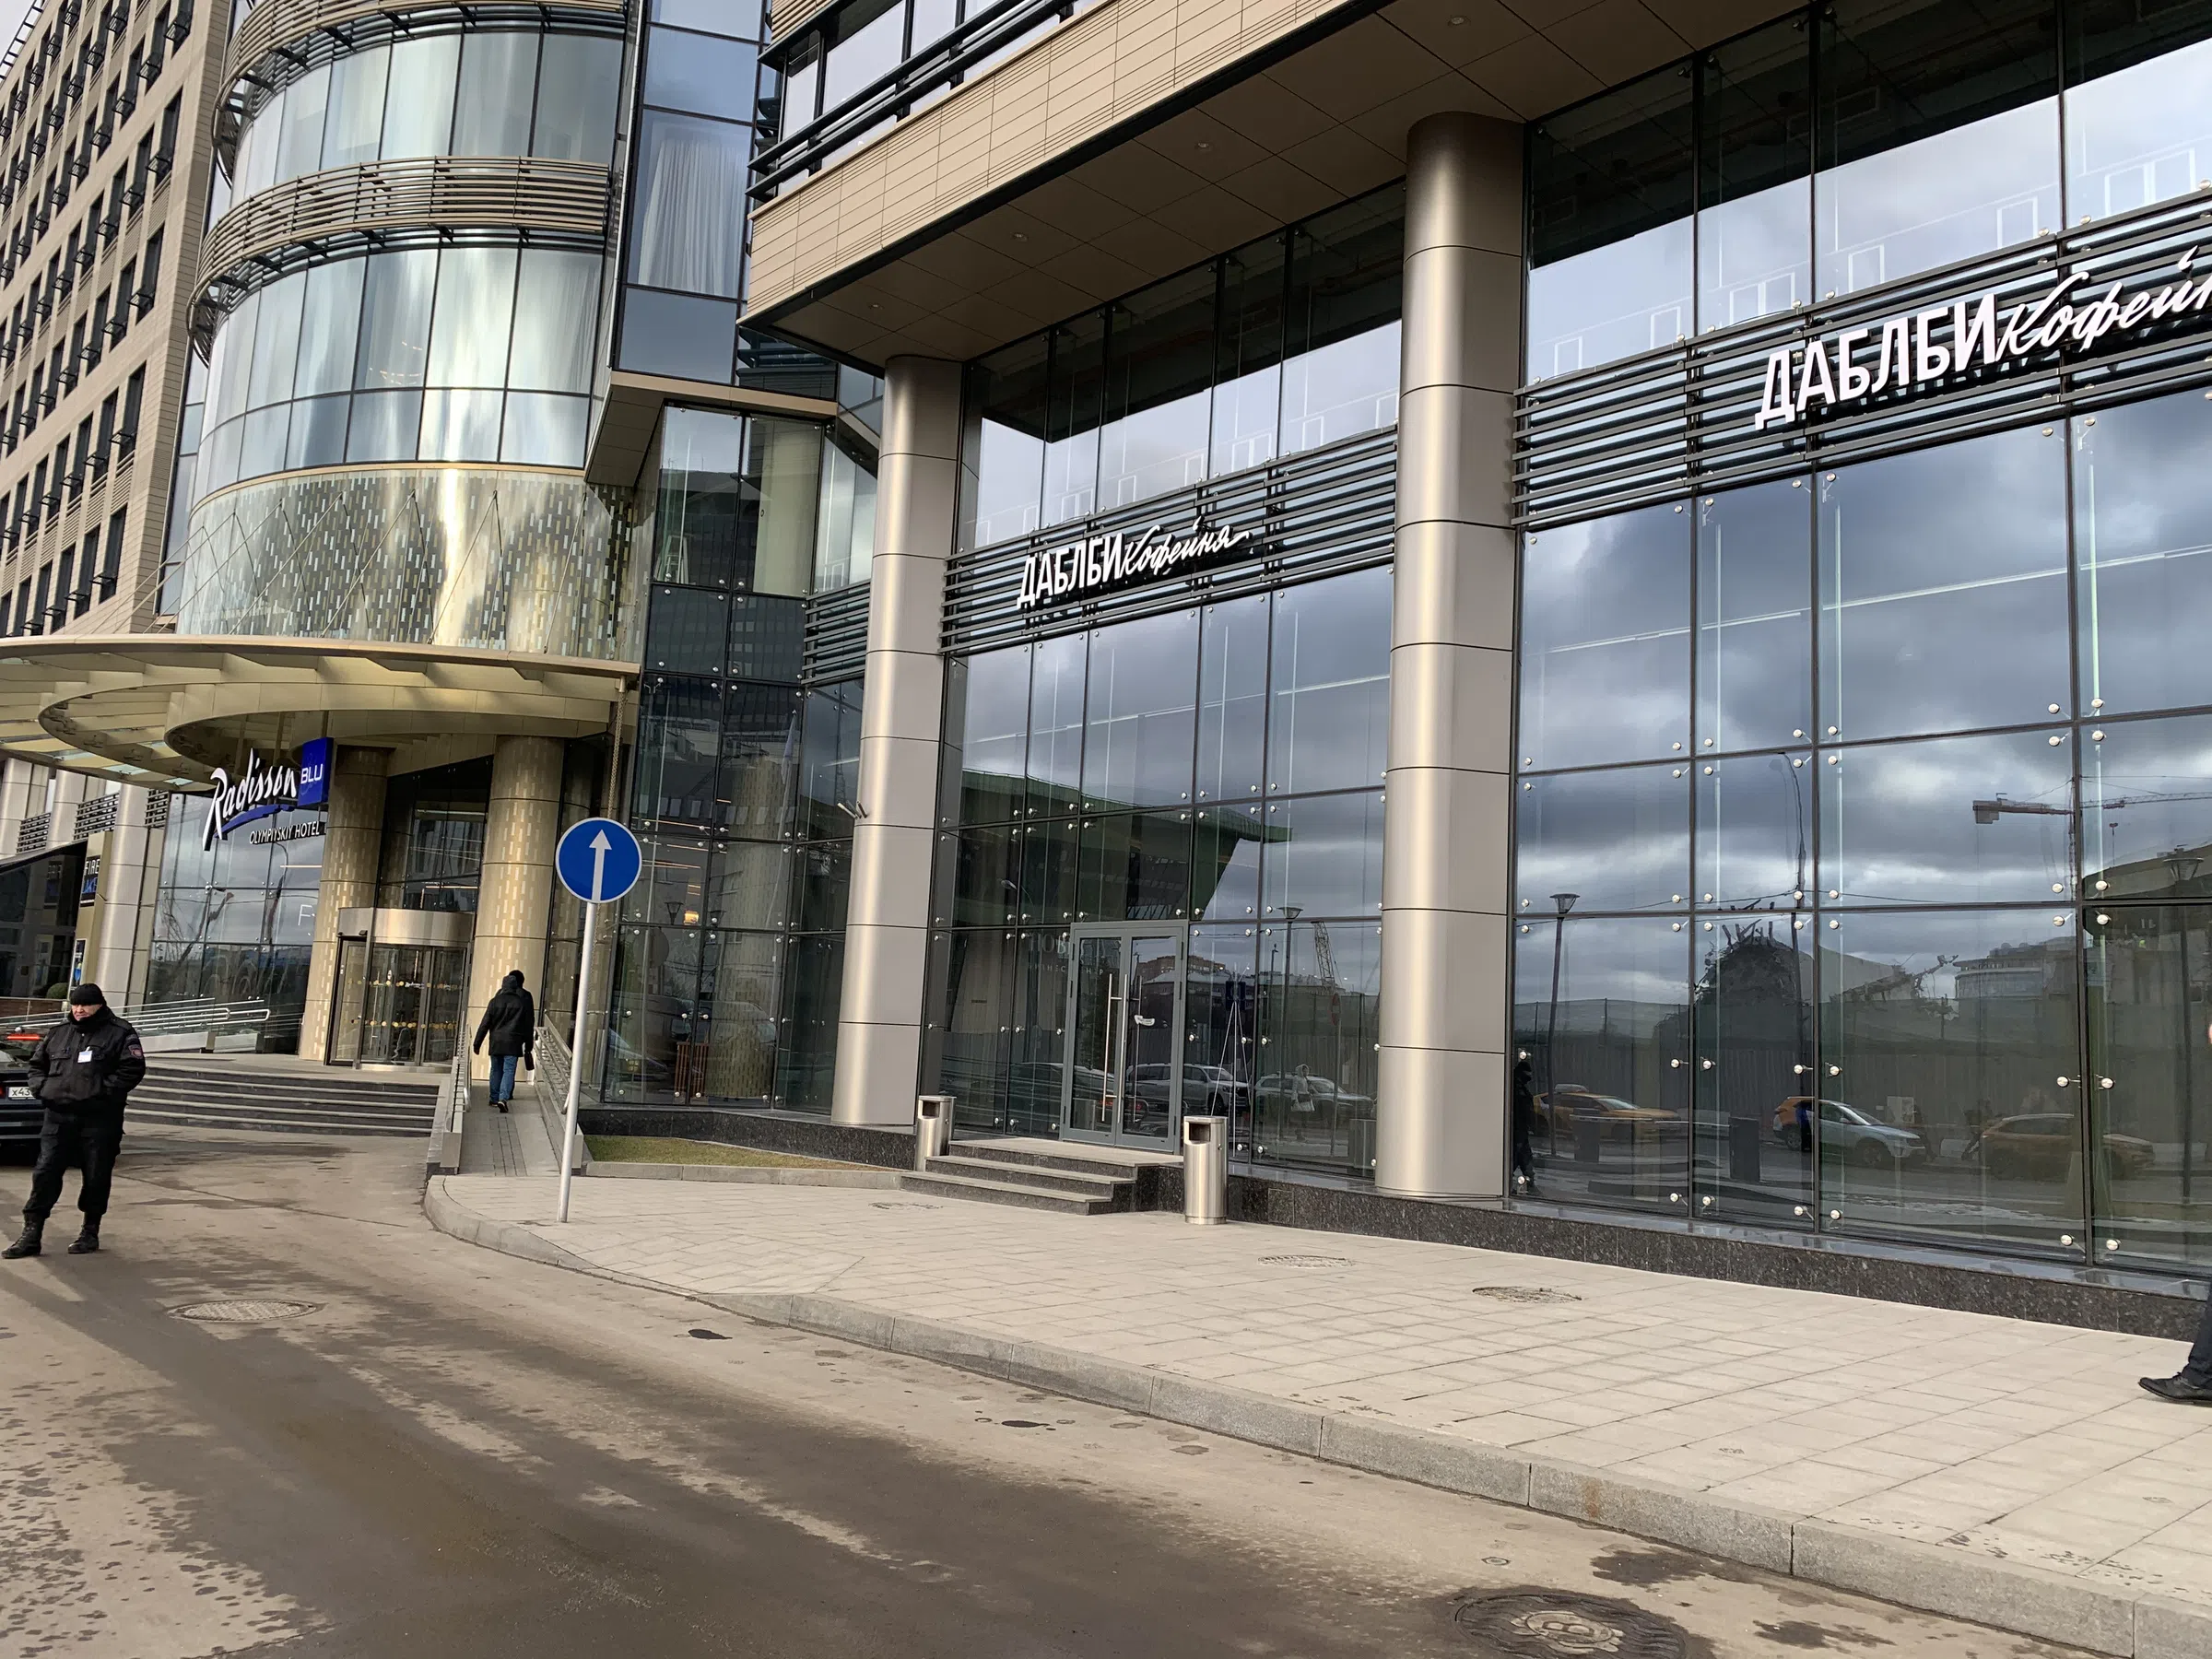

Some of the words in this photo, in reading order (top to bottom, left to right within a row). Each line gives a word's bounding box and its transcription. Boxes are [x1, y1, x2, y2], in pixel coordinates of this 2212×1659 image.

[1754, 293, 1997, 431] ДАБЛБИ
[1017, 532, 1124, 609] ДАБЛБИ
[1121, 516, 1252, 576] Кофейня
[202, 747, 297, 852] Radisson
[300, 763, 324, 784] BLU
[249, 826, 292, 845] OLYMPIYSKIY
[294, 820, 320, 839] HOTEL
[84, 858, 100, 875] FIRE
